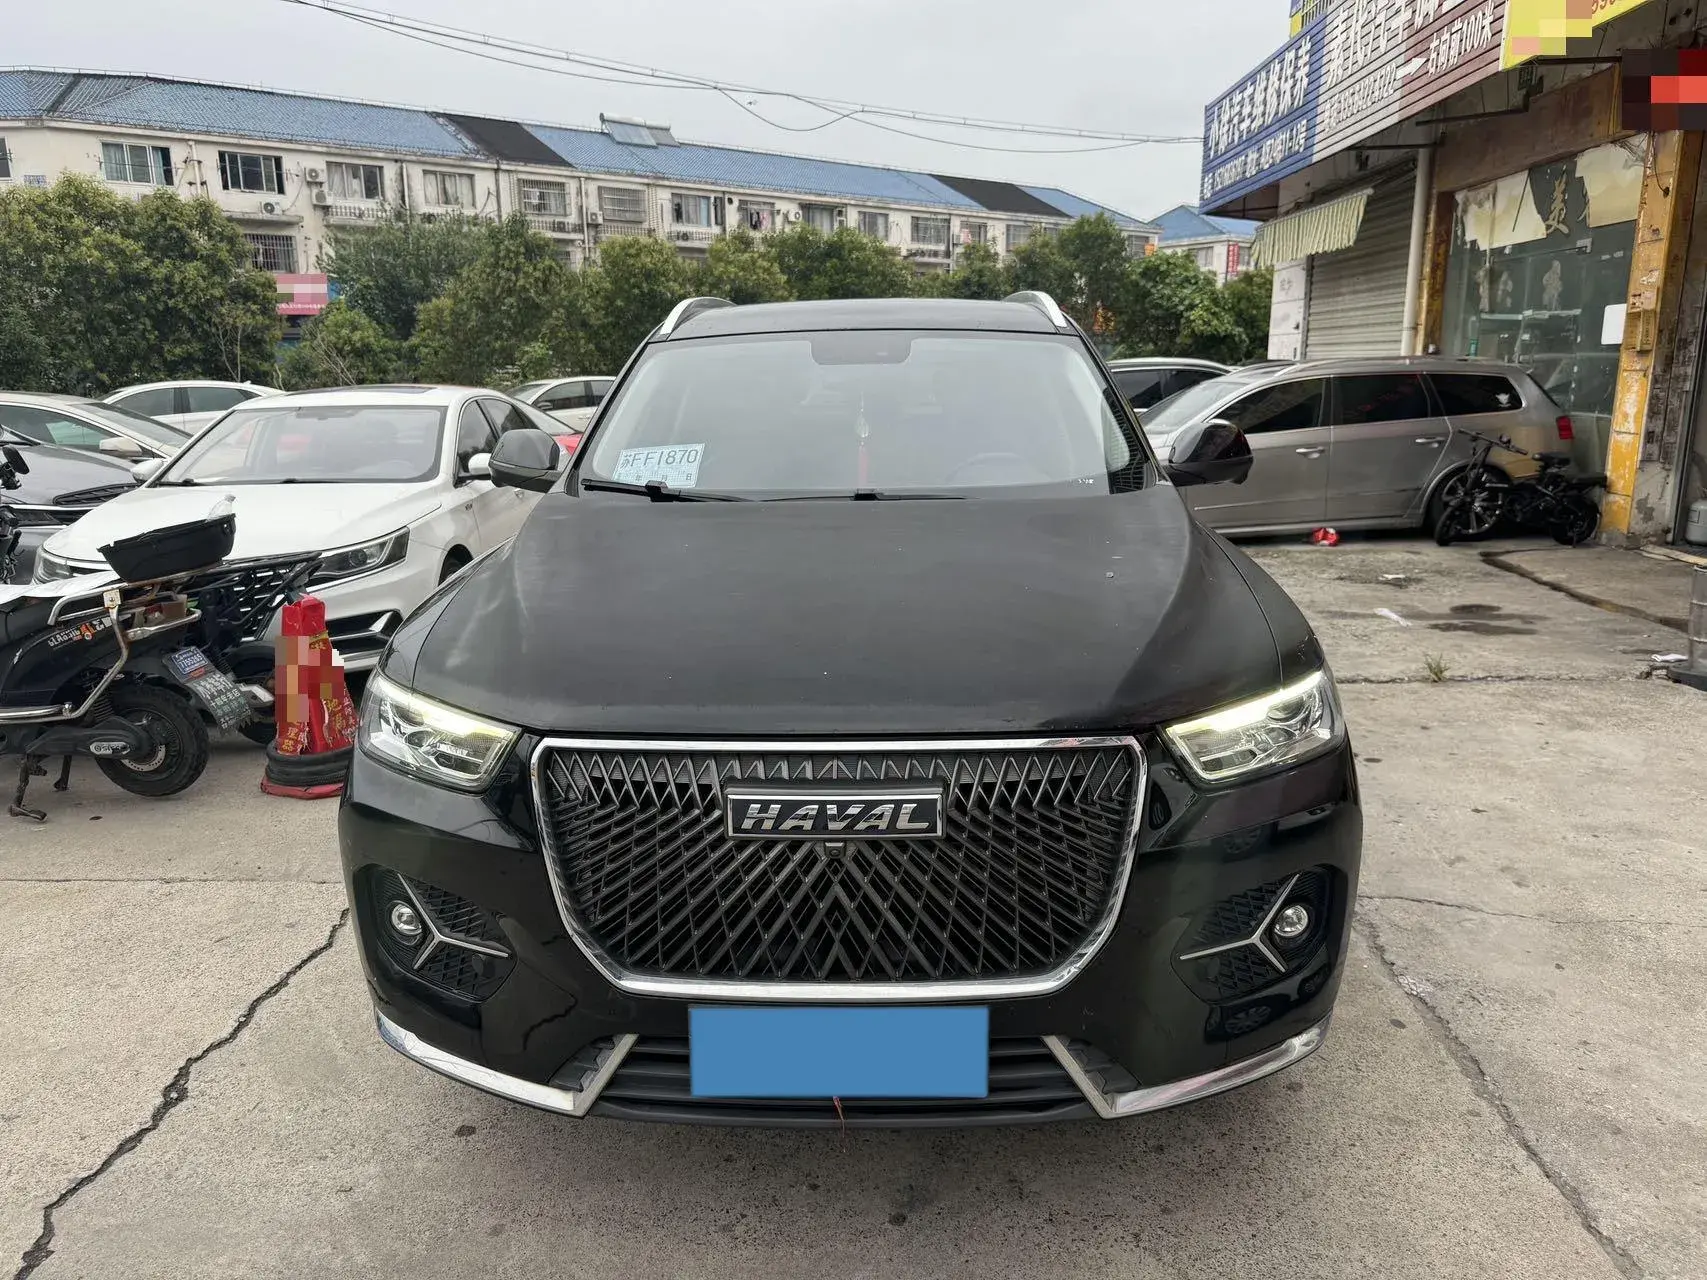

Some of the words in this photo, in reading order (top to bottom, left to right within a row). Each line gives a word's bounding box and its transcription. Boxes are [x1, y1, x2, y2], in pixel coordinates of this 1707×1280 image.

[1428, 2, 1494, 77] 右向前100米
[741, 803, 930, 831] HAVAL
